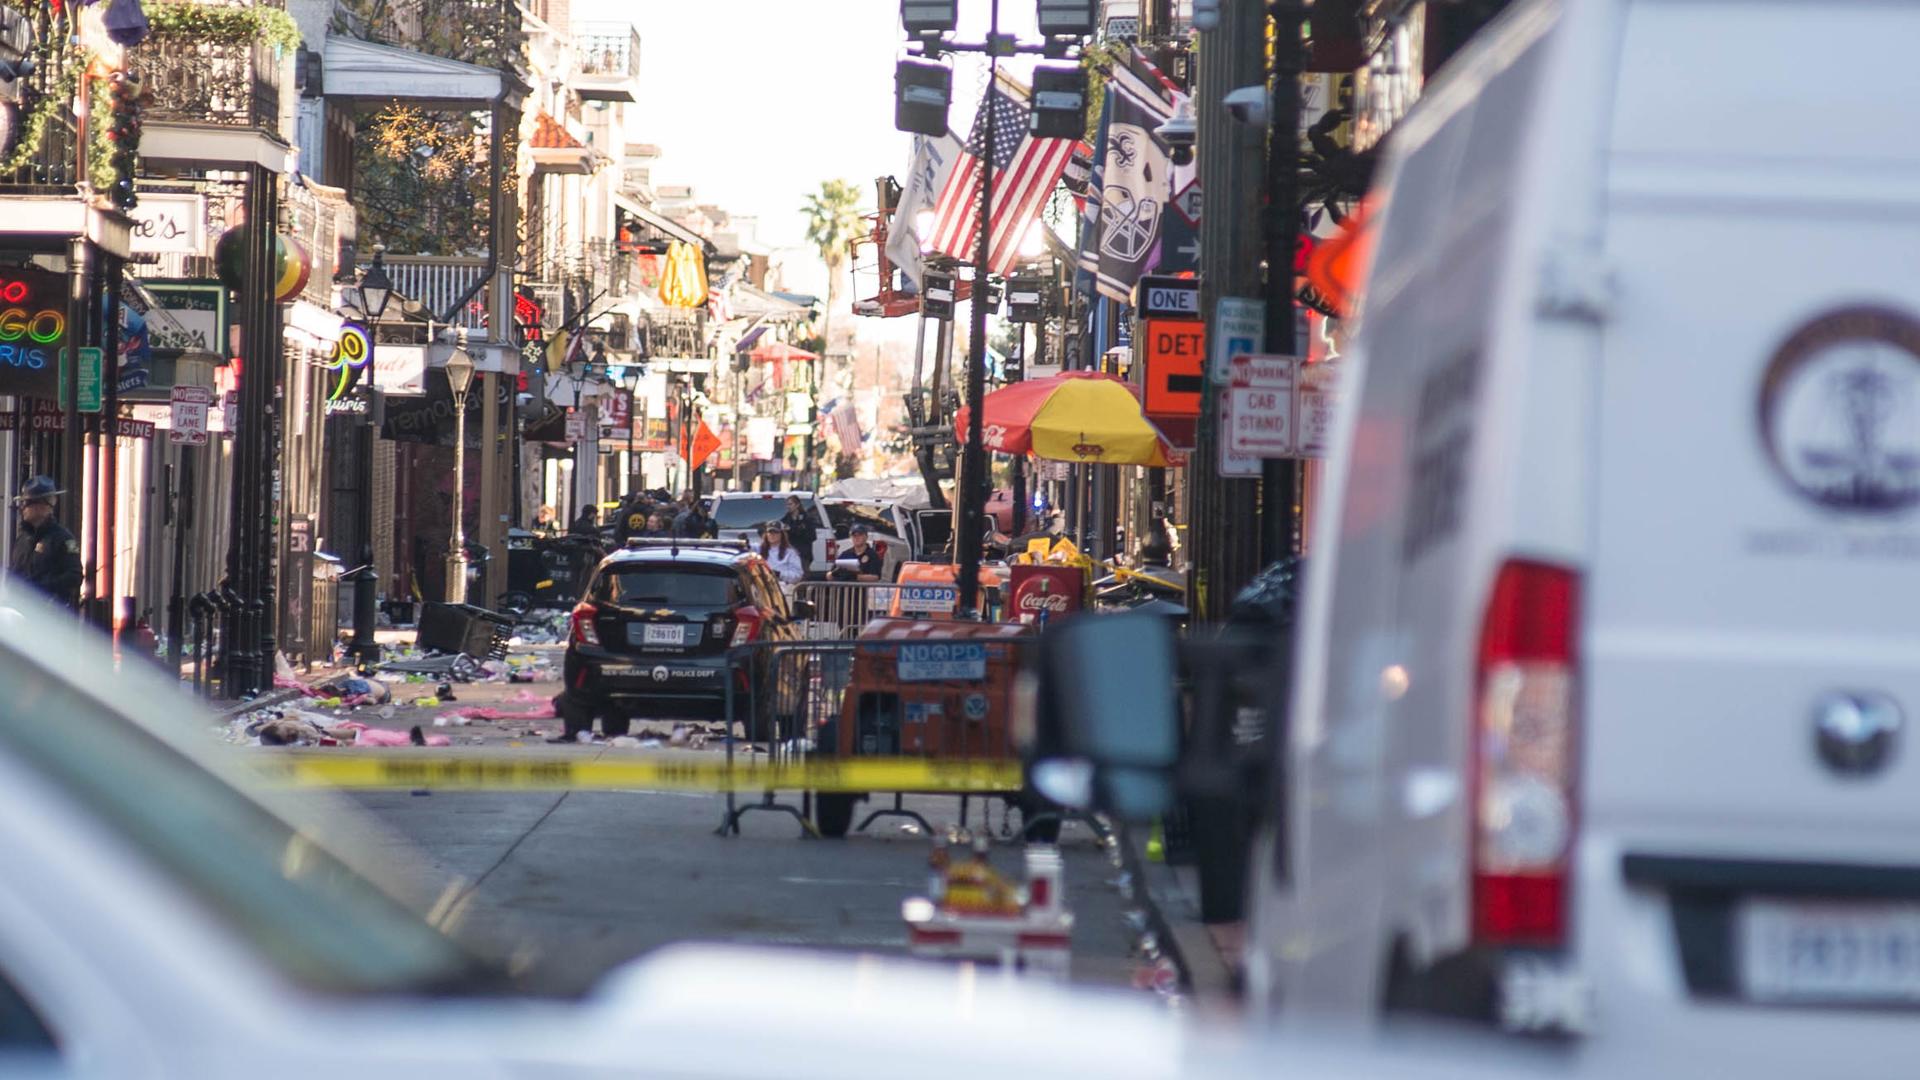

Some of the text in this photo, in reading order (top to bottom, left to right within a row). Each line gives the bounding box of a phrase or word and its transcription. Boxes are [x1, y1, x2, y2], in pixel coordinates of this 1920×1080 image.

[1152, 291, 1189, 309] ONE
[1158, 333, 1203, 355] DET
[1248, 393, 1276, 409] CAB
[180, 405, 199, 416] FIRE
[178, 418, 200, 429] LANE
[1239, 415, 1284, 431] STAND
[1021, 592, 1071, 612] Coca-Cola
